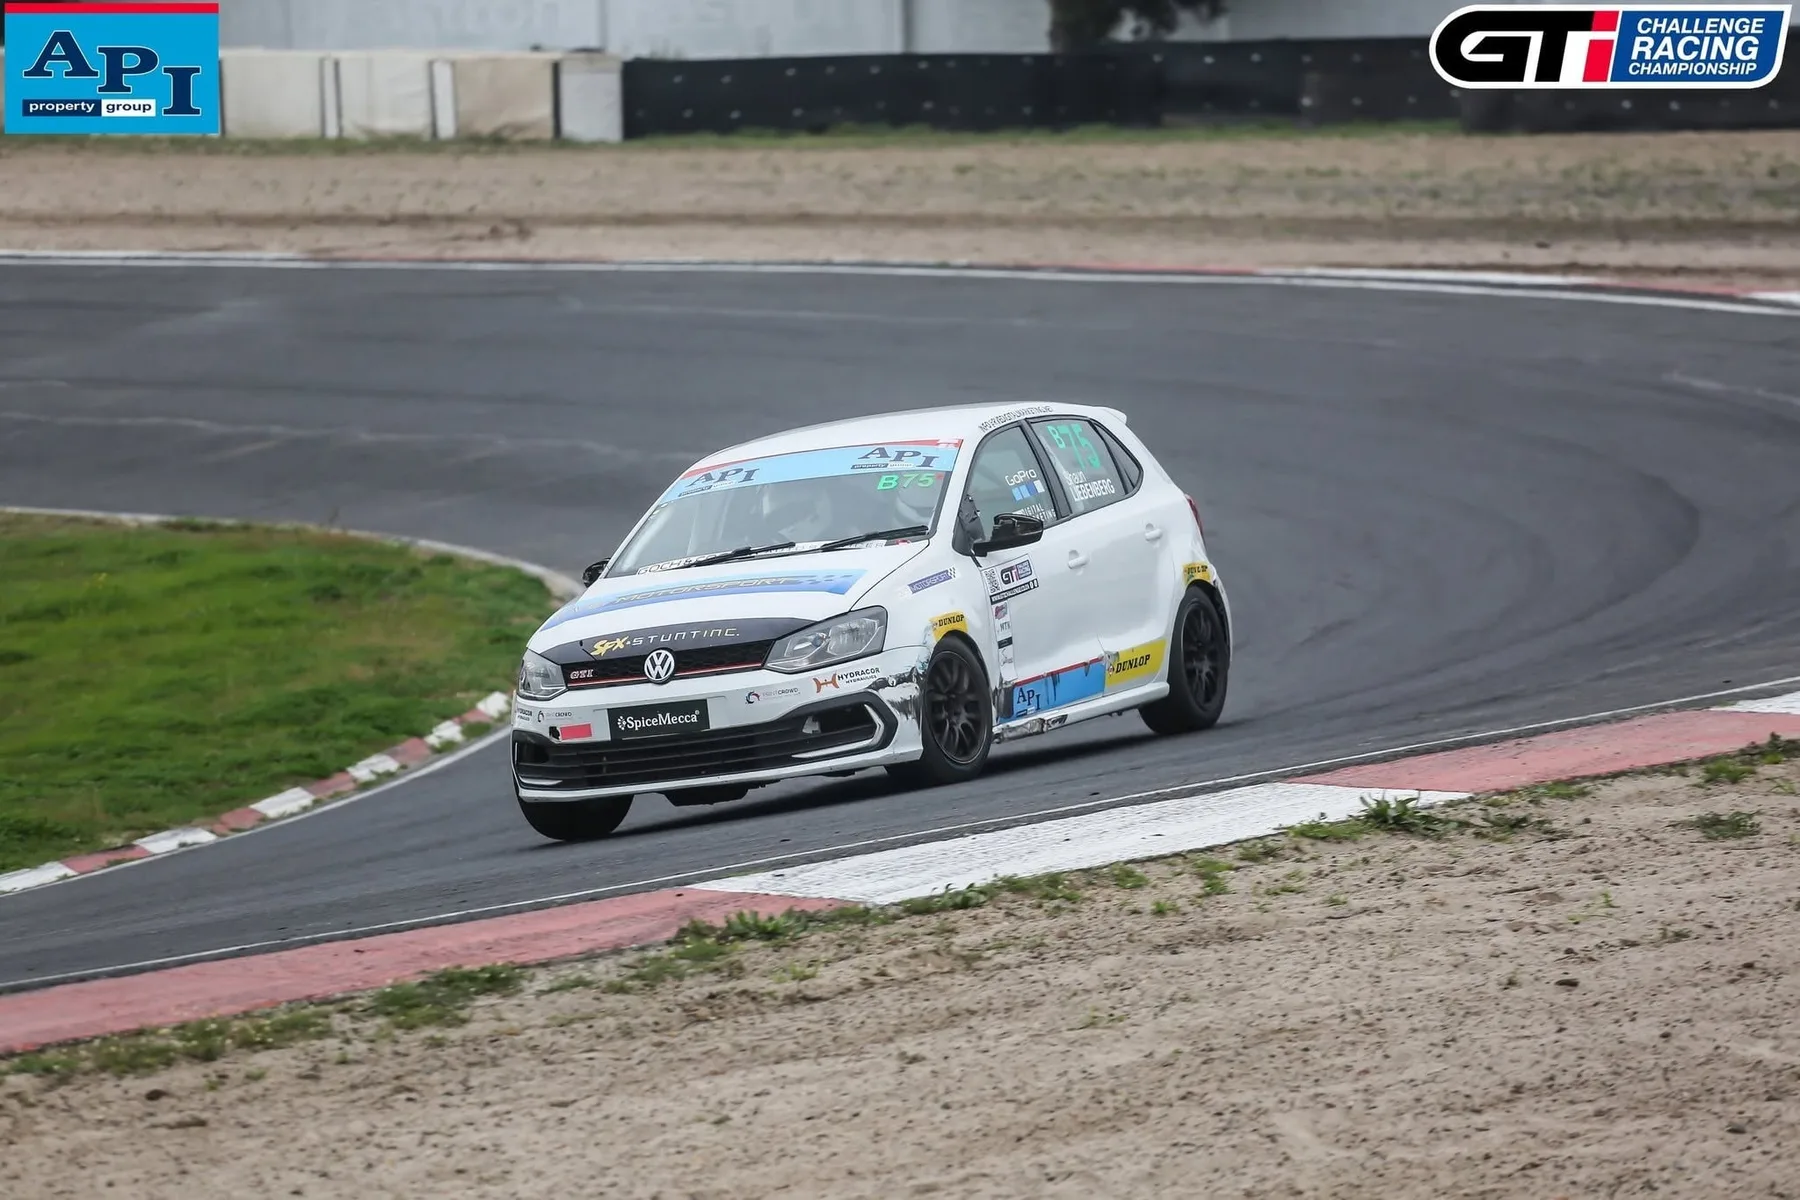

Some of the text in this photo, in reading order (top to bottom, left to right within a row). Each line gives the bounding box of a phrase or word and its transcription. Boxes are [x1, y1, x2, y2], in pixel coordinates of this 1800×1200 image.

[857, 446, 940, 468] API
[684, 467, 760, 488] API
[1004, 469, 1037, 486] GoPro
[615, 575, 797, 605] MOTORSPORT
[938, 614, 965, 627] DUNLOP
[837, 667, 881, 681] HYDRACOR
[1115, 654, 1151, 674] DUNLOP
[1016, 687, 1042, 711] API
[627, 710, 698, 730] SpiceMecca
